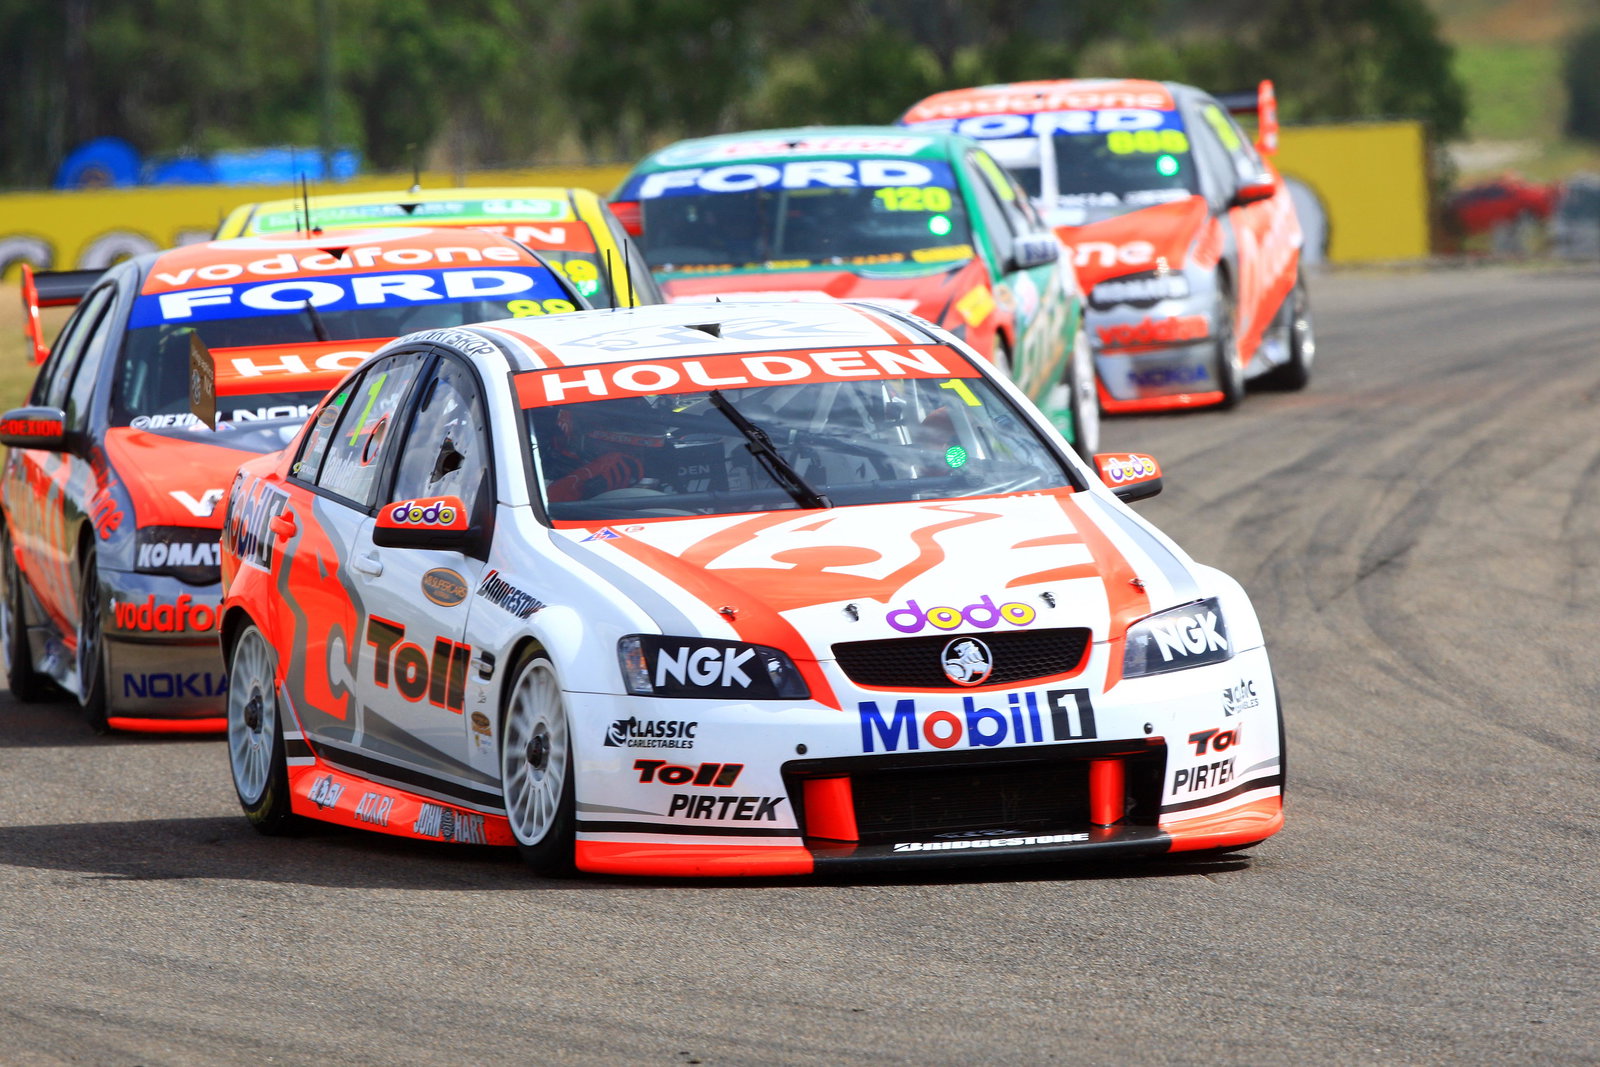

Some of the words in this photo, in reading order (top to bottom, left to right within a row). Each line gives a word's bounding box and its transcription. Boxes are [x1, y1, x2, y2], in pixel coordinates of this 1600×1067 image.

[640, 159, 933, 198] FORD
[874, 187, 952, 212] 120
[155, 246, 520, 286] vodafone
[159, 270, 535, 320] FORD
[541, 346, 951, 402] HOLDEN
[939, 378, 983, 407] 1
[8, 419, 63, 437] DEXION
[1107, 454, 1154, 482] dodo
[392, 501, 456, 525] dodo
[886, 594, 1036, 633] dodo
[1150, 611, 1228, 662] NGK
[366, 613, 472, 716] Toll
[655, 646, 756, 689] NGK
[629, 719, 698, 739] CLASSIC
[858, 691, 1043, 753] Mobil
[1054, 691, 1089, 738] 1
[628, 739, 694, 749] CARLECTABLES
[633, 759, 744, 787] Toll
[354, 791, 396, 827] ATARI
[413, 803, 443, 838] JOHN
[454, 811, 488, 845] HART
[668, 794, 786, 821] PIRTEK
[893, 833, 1090, 852] BRIDGESTONE
